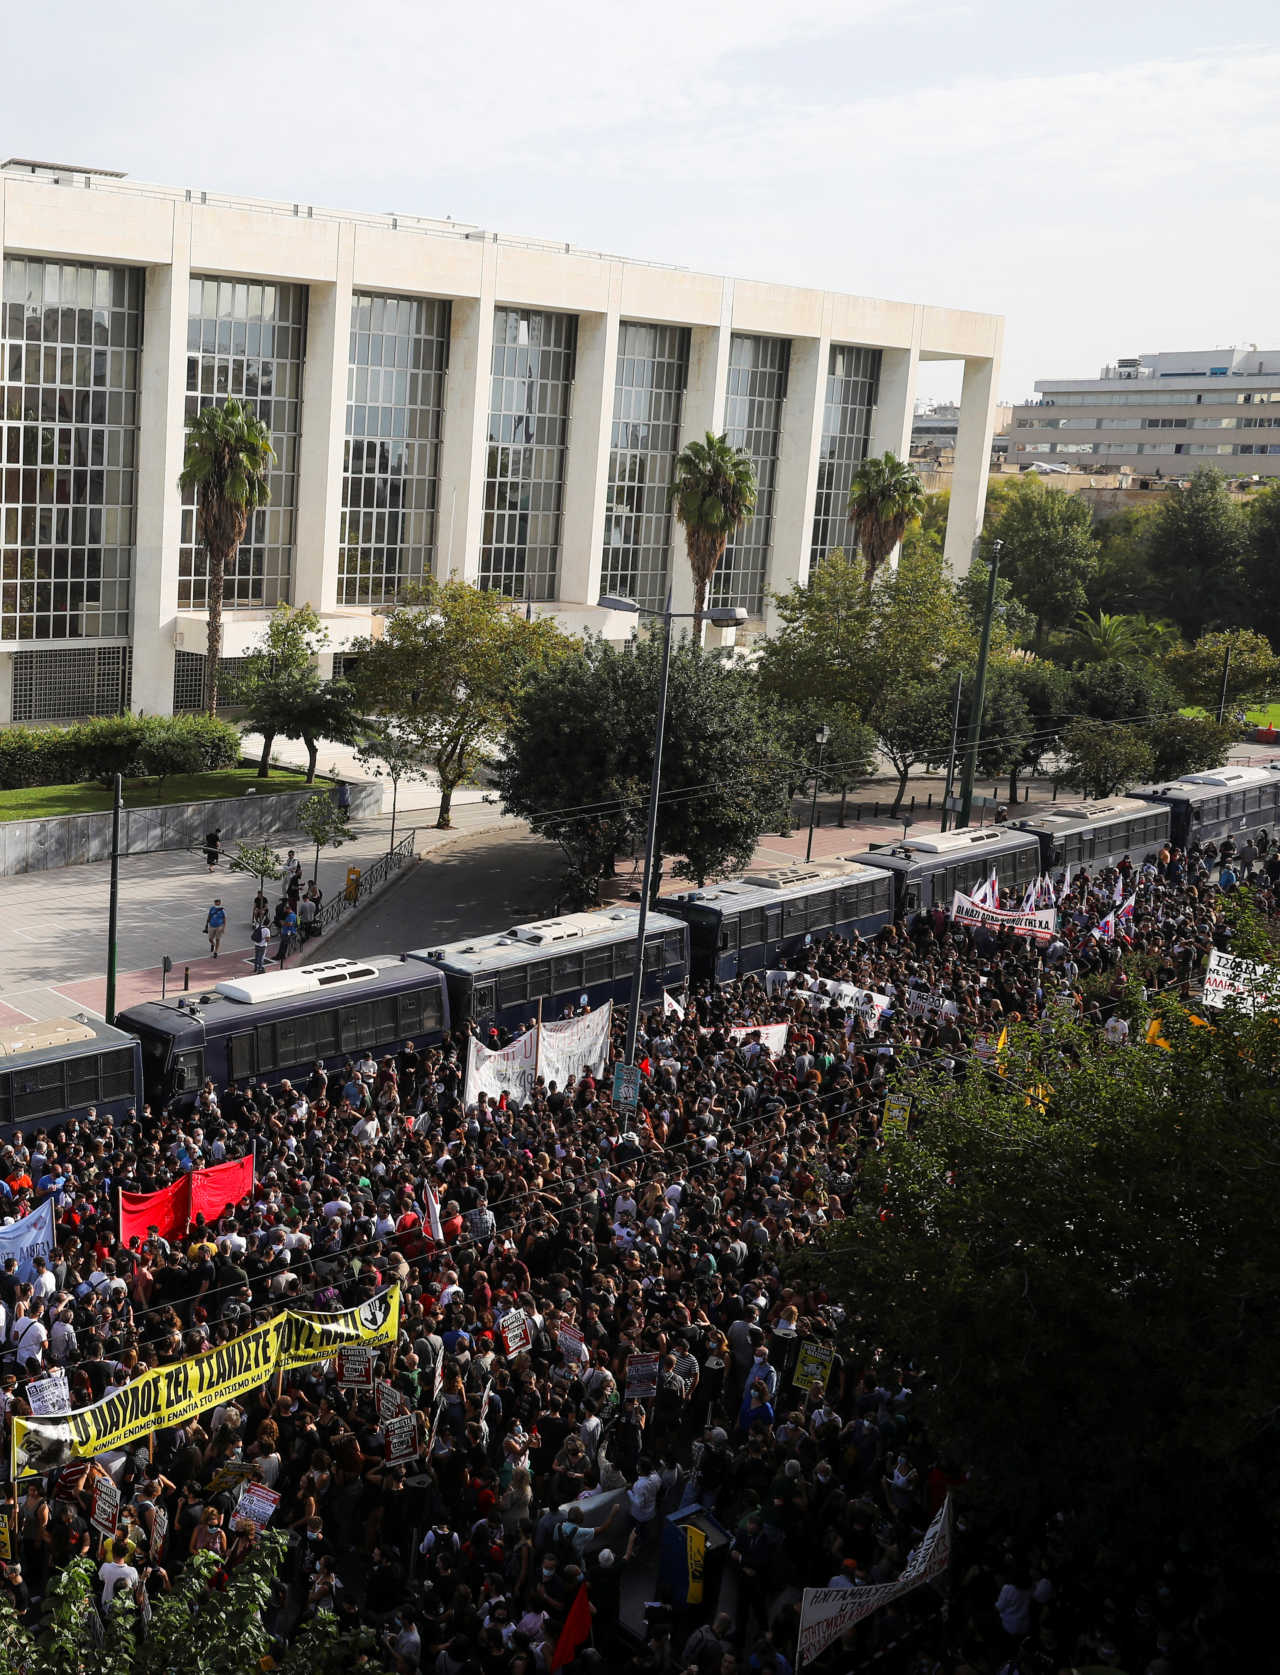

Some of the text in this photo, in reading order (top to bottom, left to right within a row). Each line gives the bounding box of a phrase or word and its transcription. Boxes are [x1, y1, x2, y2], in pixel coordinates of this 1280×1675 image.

[89, 1375, 161, 1439] ΠΑΥΛΟΣ
[194, 1328, 271, 1394] ΤΣΑΚΙΣΤΕ
[273, 1316, 316, 1354] ΤΟΥΣ
[93, 1434, 122, 1453] ΚΙΝΗΣΗ
[123, 1415, 166, 1440] ΕΝΩΜΕΝΟΙ
[167, 1401, 199, 1422] ΕΝΑΝΤΙΑ
[199, 1392, 213, 1408] ΣΤΟ
[214, 1380, 250, 1402] ΡΑΤΣΙΣΜΟ
[251, 1373, 263, 1386] ΚΑΙ
